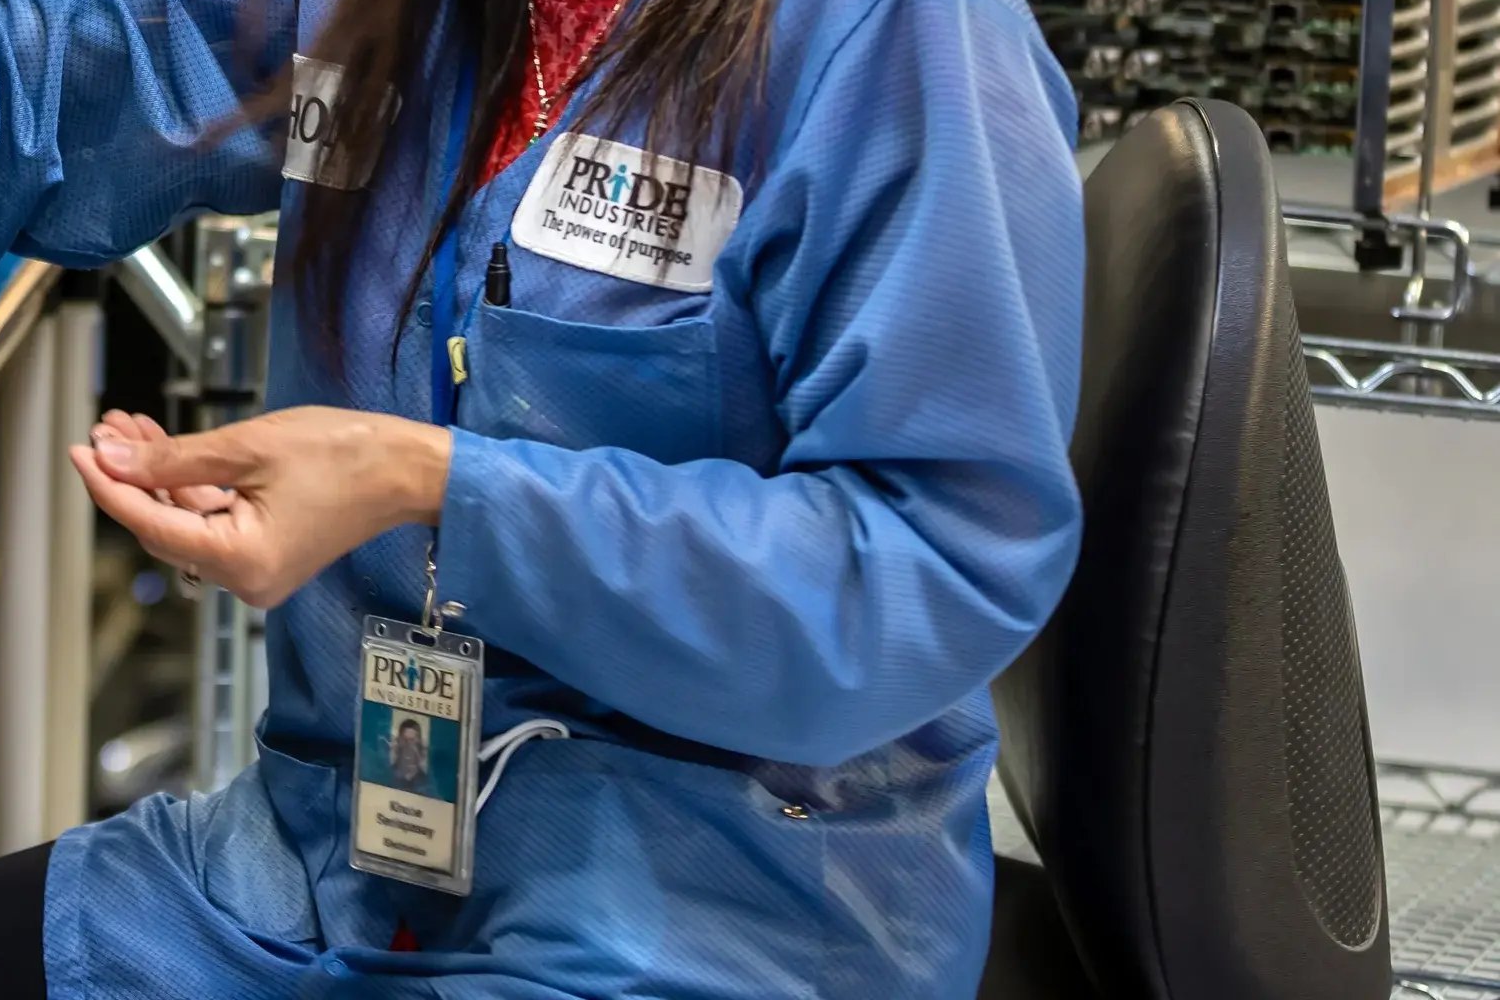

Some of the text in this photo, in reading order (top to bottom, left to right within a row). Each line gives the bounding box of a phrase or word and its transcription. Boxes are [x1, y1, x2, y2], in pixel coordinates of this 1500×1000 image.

[542, 209, 693, 266] The power of purpose
[558, 191, 682, 240] INDUSTRIES
